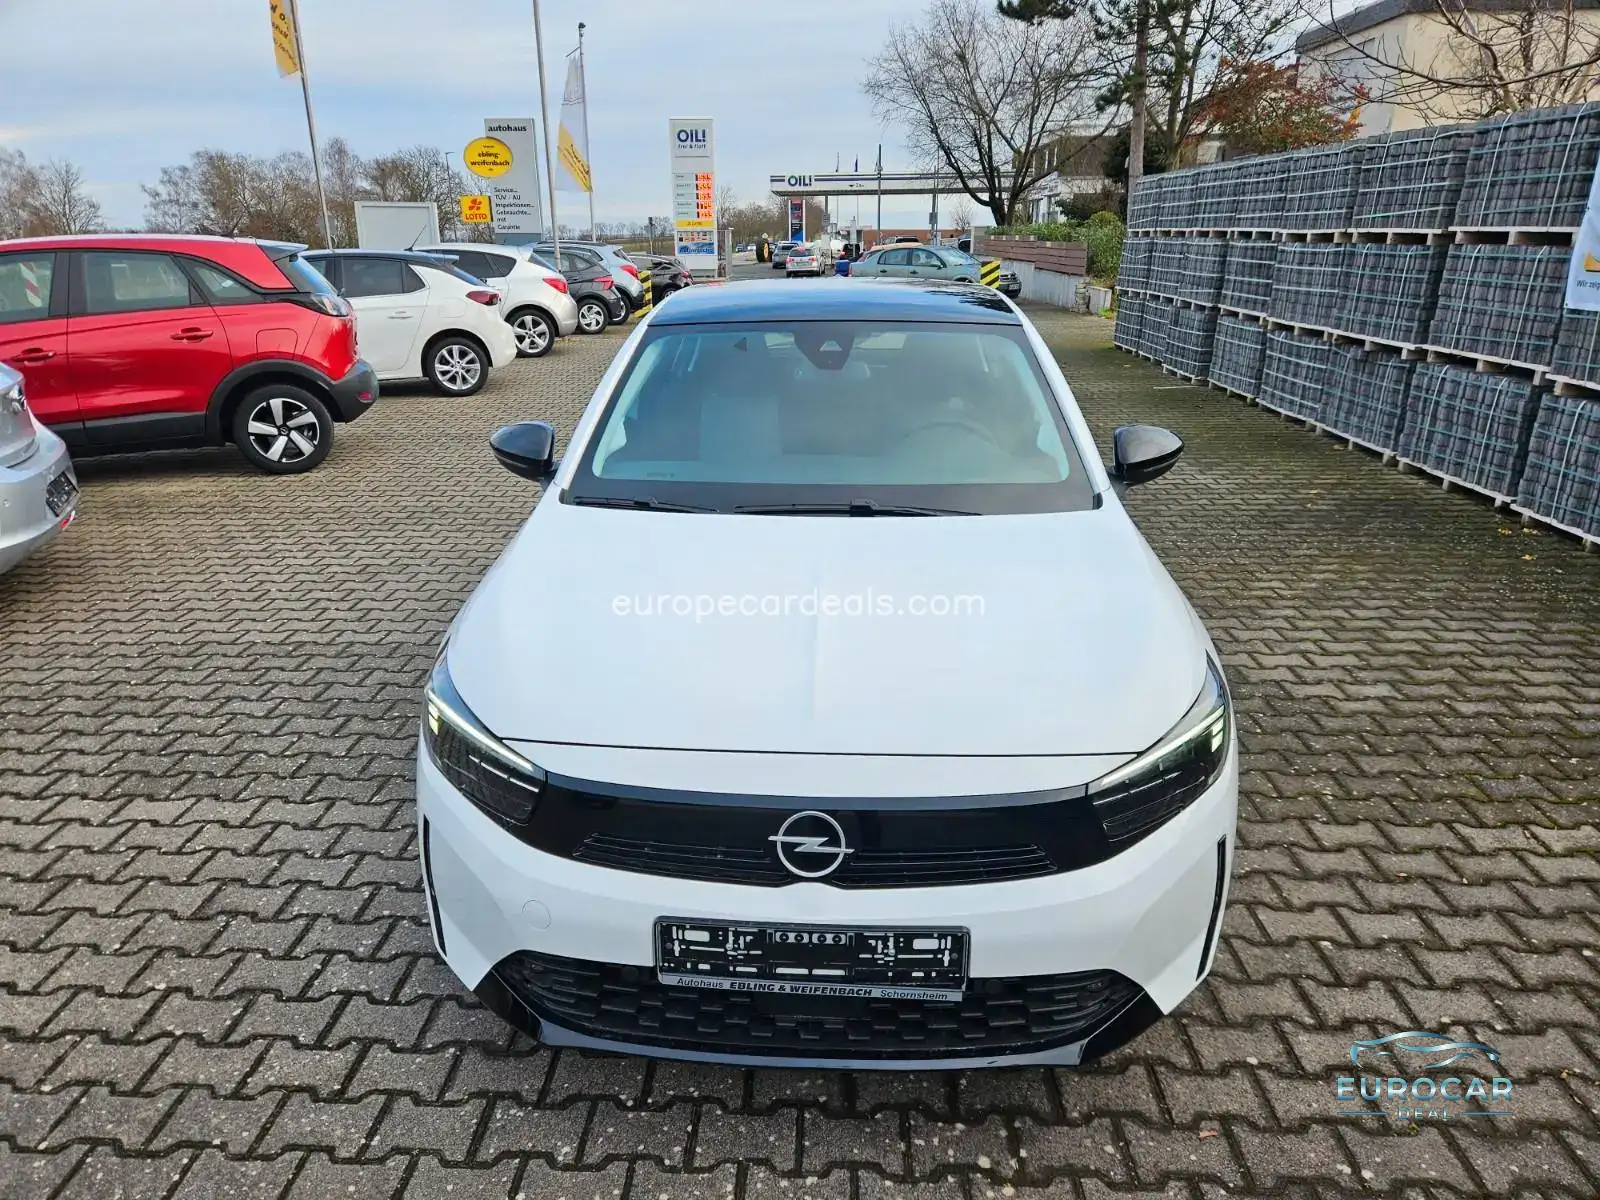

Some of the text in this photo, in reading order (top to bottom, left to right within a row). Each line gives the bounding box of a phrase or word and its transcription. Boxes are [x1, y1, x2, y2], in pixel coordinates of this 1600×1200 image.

[488, 124, 527, 132] autohaus
[677, 129, 706, 142] OIL!
[788, 175, 812, 187] OIL!
[465, 213, 488, 221] LOTTO
[676, 977, 948, 1001] Autohaus EBLING & WEIFENBACH Schornsheim
